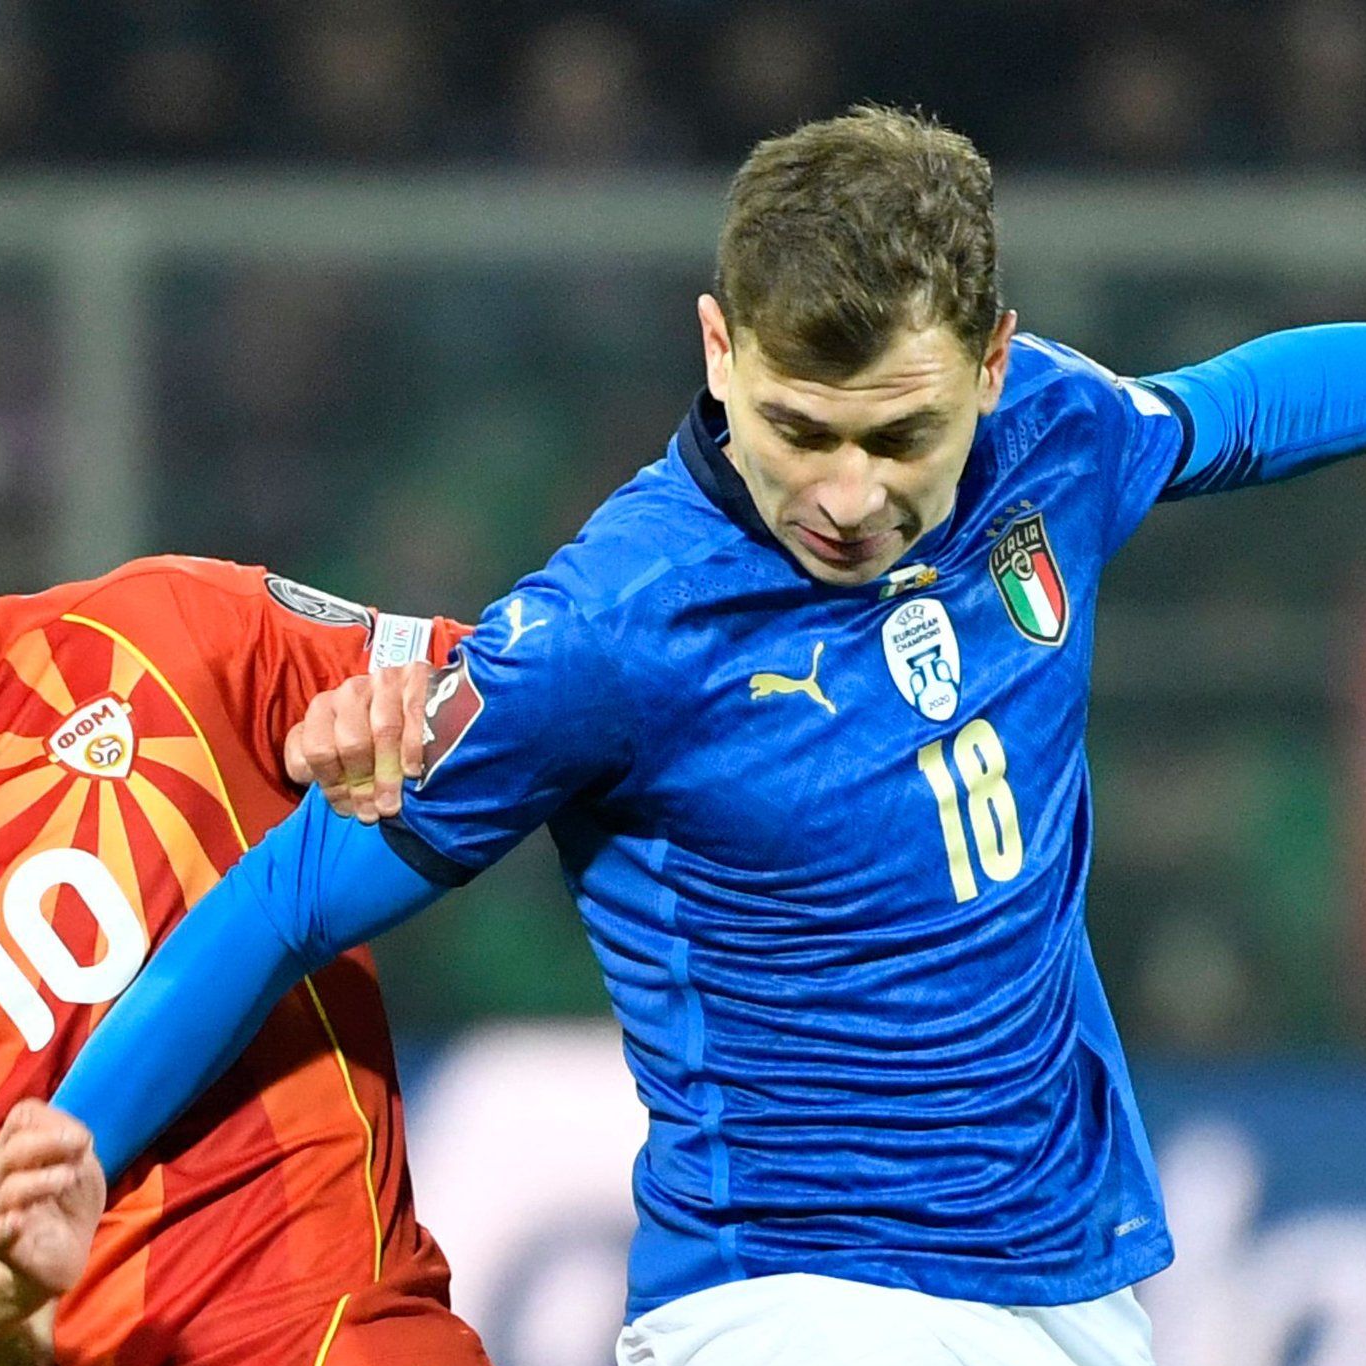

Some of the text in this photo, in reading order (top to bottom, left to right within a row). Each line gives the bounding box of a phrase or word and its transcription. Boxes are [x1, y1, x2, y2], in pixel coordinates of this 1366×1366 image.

[995, 523, 1040, 567] ITALIA
[892, 617, 939, 645] EUROPEAN
[895, 627, 942, 654] CHAMPIONS
[57, 704, 115, 749] ФФМ
[916, 718, 1024, 904] 18
